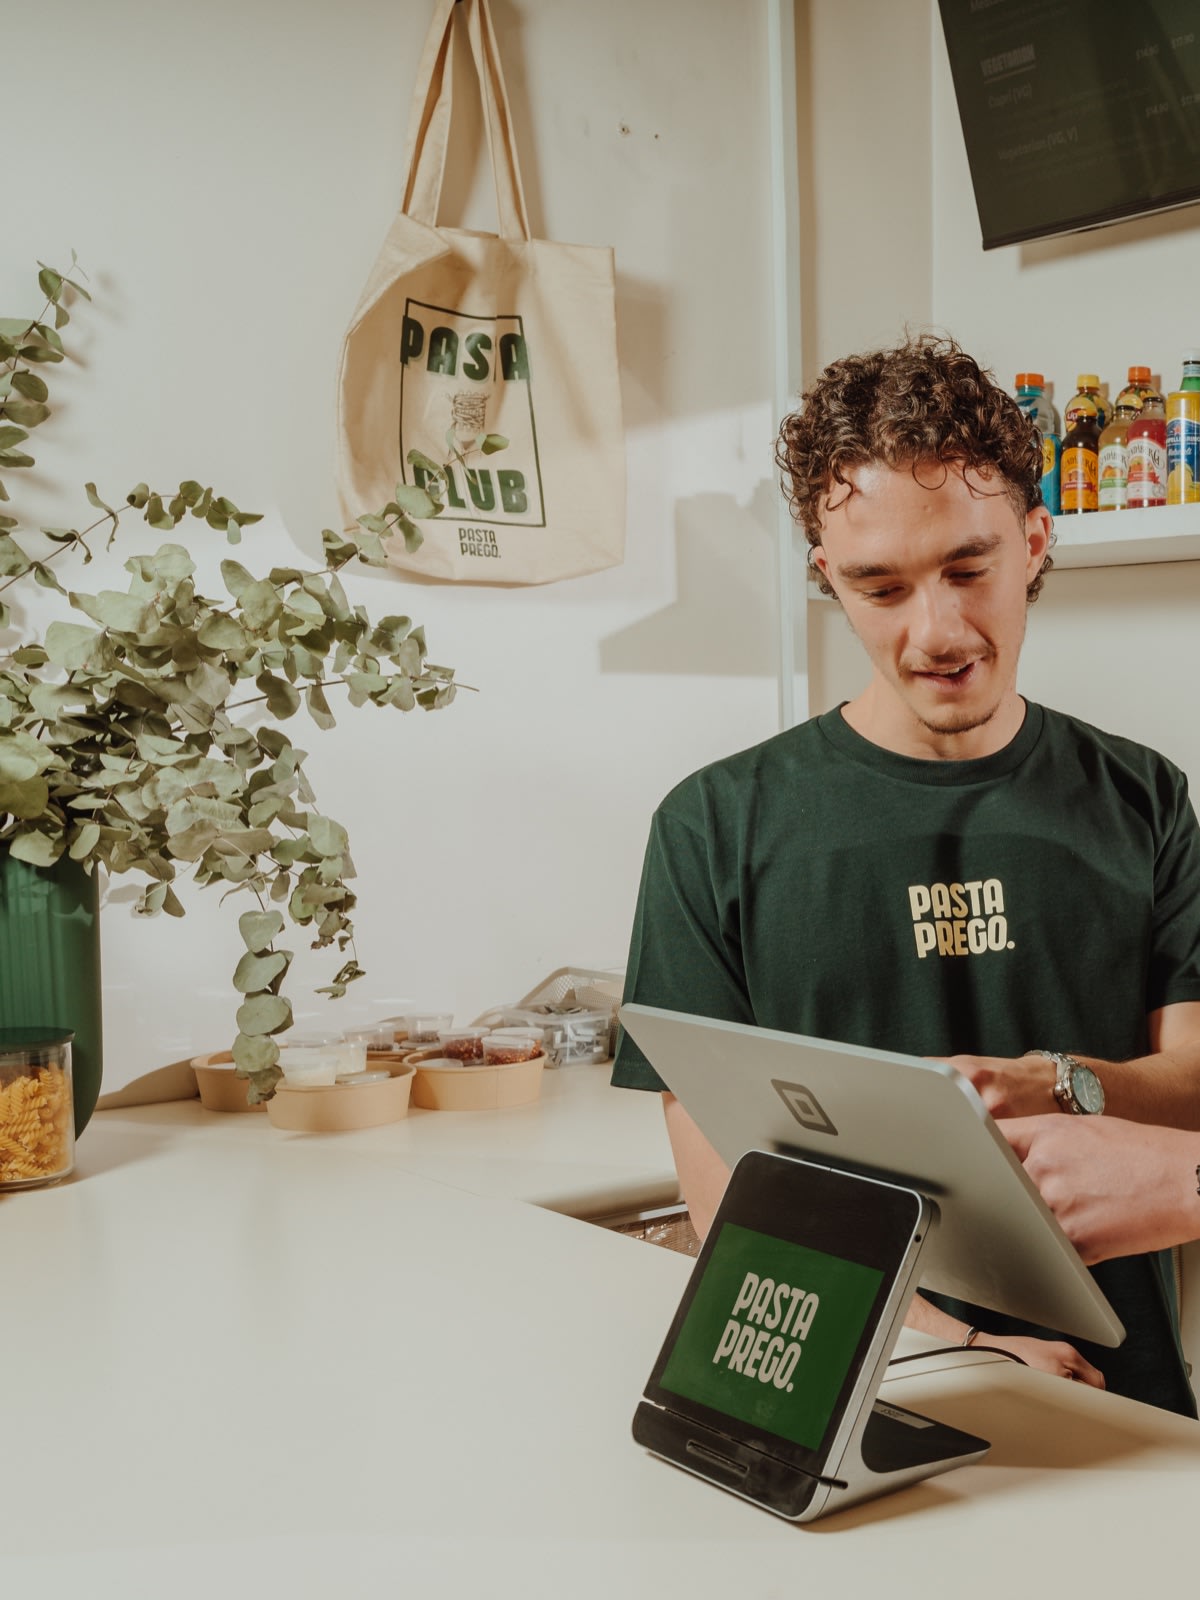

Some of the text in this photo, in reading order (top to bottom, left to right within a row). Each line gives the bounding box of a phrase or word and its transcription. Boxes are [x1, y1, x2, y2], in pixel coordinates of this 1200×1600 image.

[400, 315, 530, 381] PASA
[458, 528, 497, 543] PASTA
[460, 542, 501, 559] PREGO.
[908, 878, 1005, 921] PASTA
[913, 914, 1016, 958] PREGO.
[731, 1271, 820, 1341] PASTA
[712, 1319, 802, 1393] PREGO.
